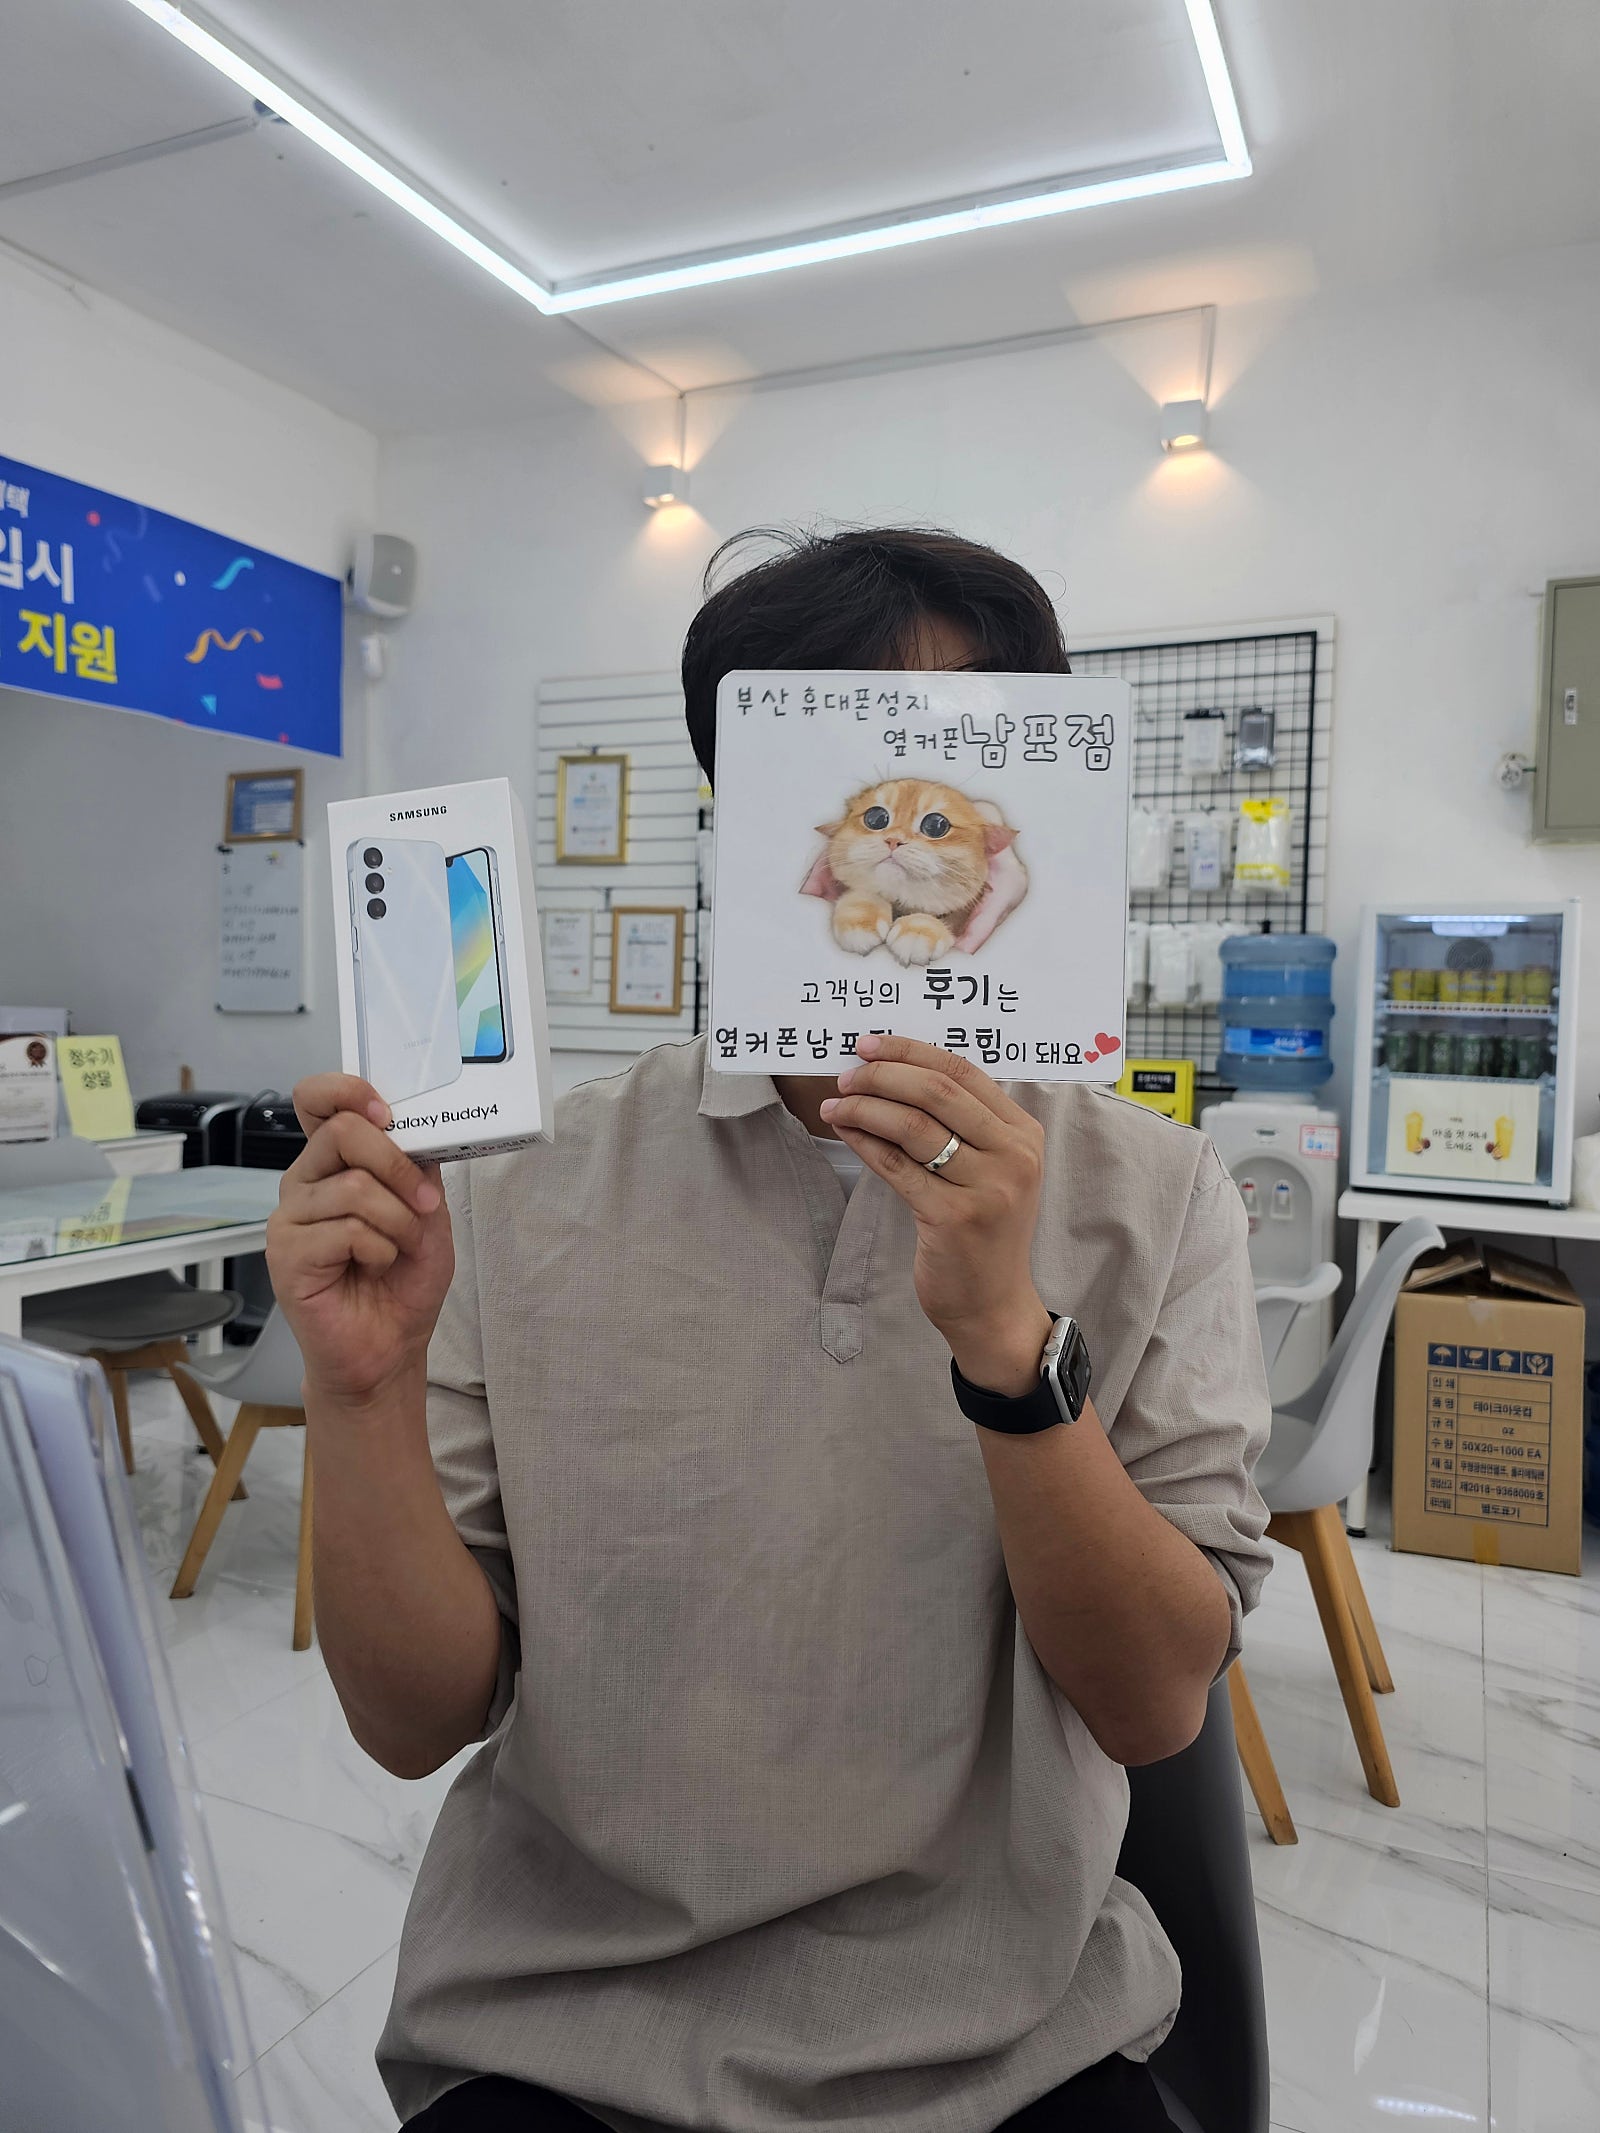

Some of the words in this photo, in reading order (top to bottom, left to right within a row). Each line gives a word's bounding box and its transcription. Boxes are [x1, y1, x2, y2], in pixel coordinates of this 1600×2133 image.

[18, 609, 118, 684] 지원
[737, 686, 789, 717] 부산
[802, 686, 929, 721] 휴대폰성지
[389, 805, 447, 822] SAMSUNG
[801, 979, 899, 1008] 고객님의
[923, 968, 1019, 1013] 후기는
[715, 1026, 893, 1060] 옆커폰남포
[1035, 1042, 1083, 1065] 돼요
[441, 1104, 499, 1123] Buddy4
[1527, 1448, 1542, 1459] EA
